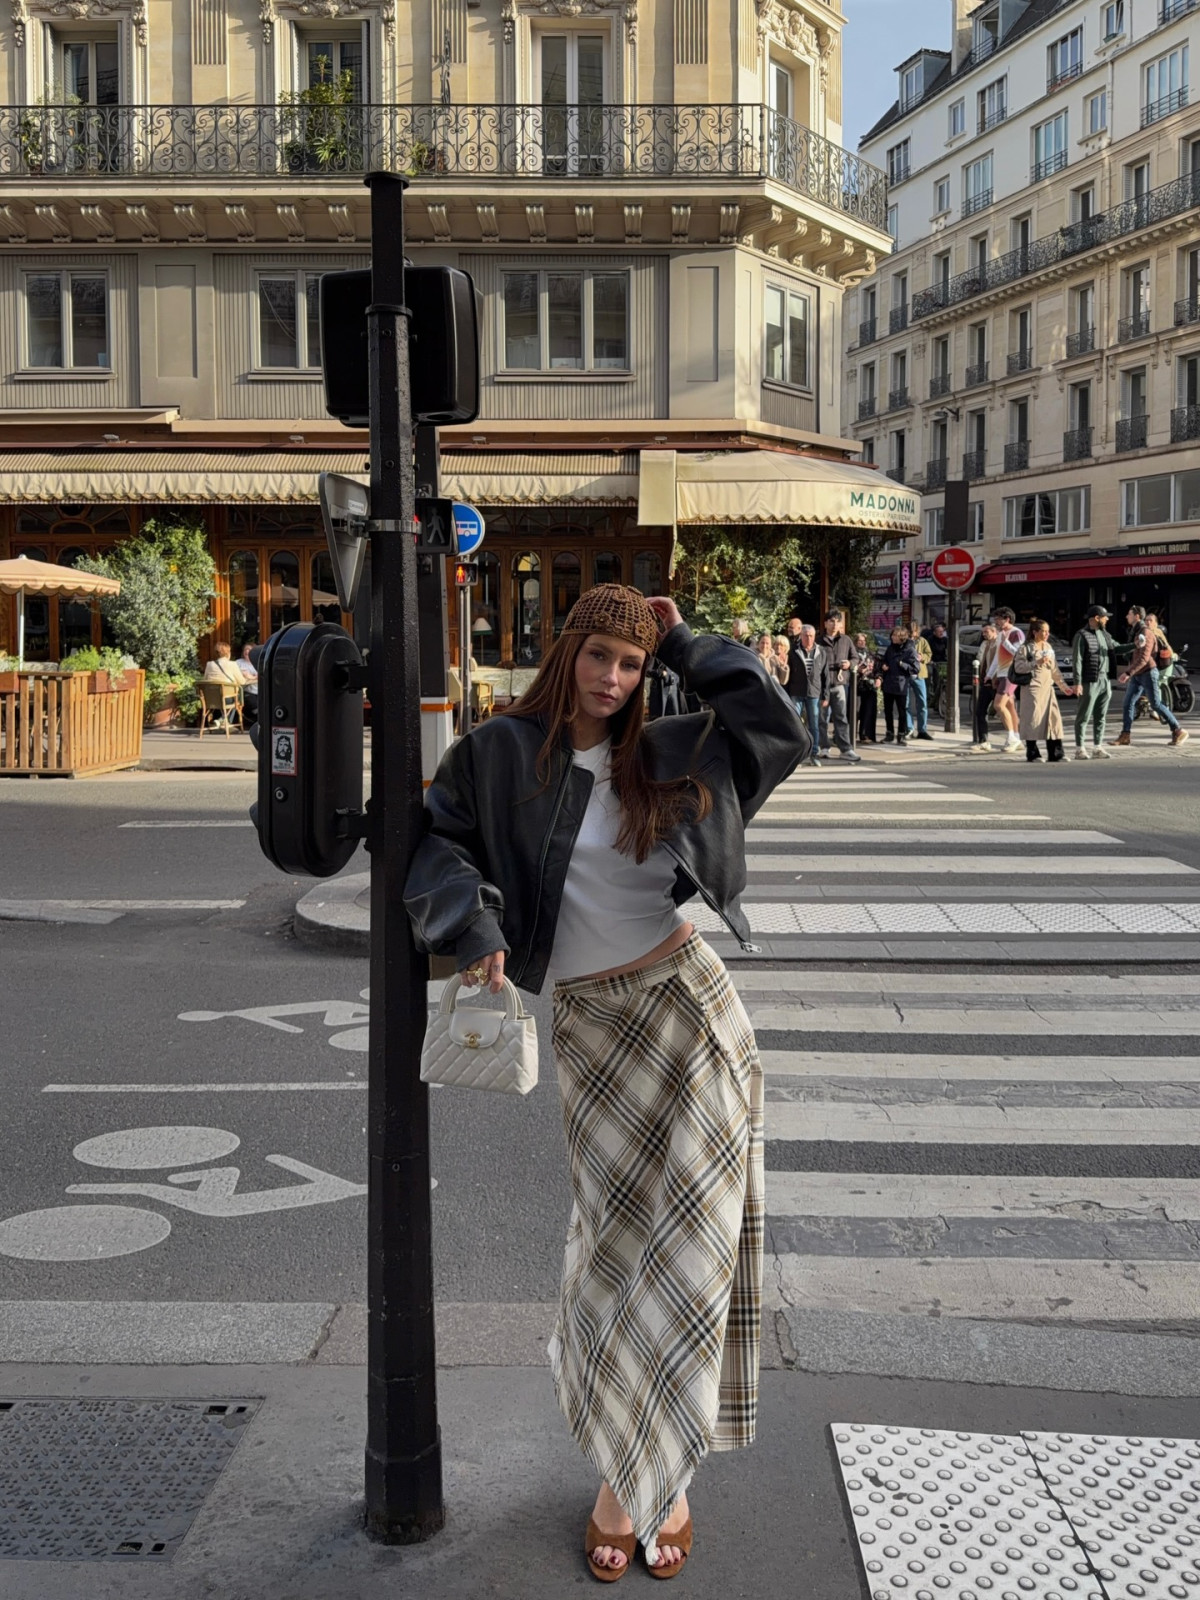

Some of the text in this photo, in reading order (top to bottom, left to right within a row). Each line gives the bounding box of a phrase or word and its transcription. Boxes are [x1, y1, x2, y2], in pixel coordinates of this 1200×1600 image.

[850, 491, 915, 515] MADONNA
[1138, 546, 1146, 555] LA
[1147, 545, 1167, 555] POINTE
[1123, 564, 1176, 576] LA POINTE DROUOT
